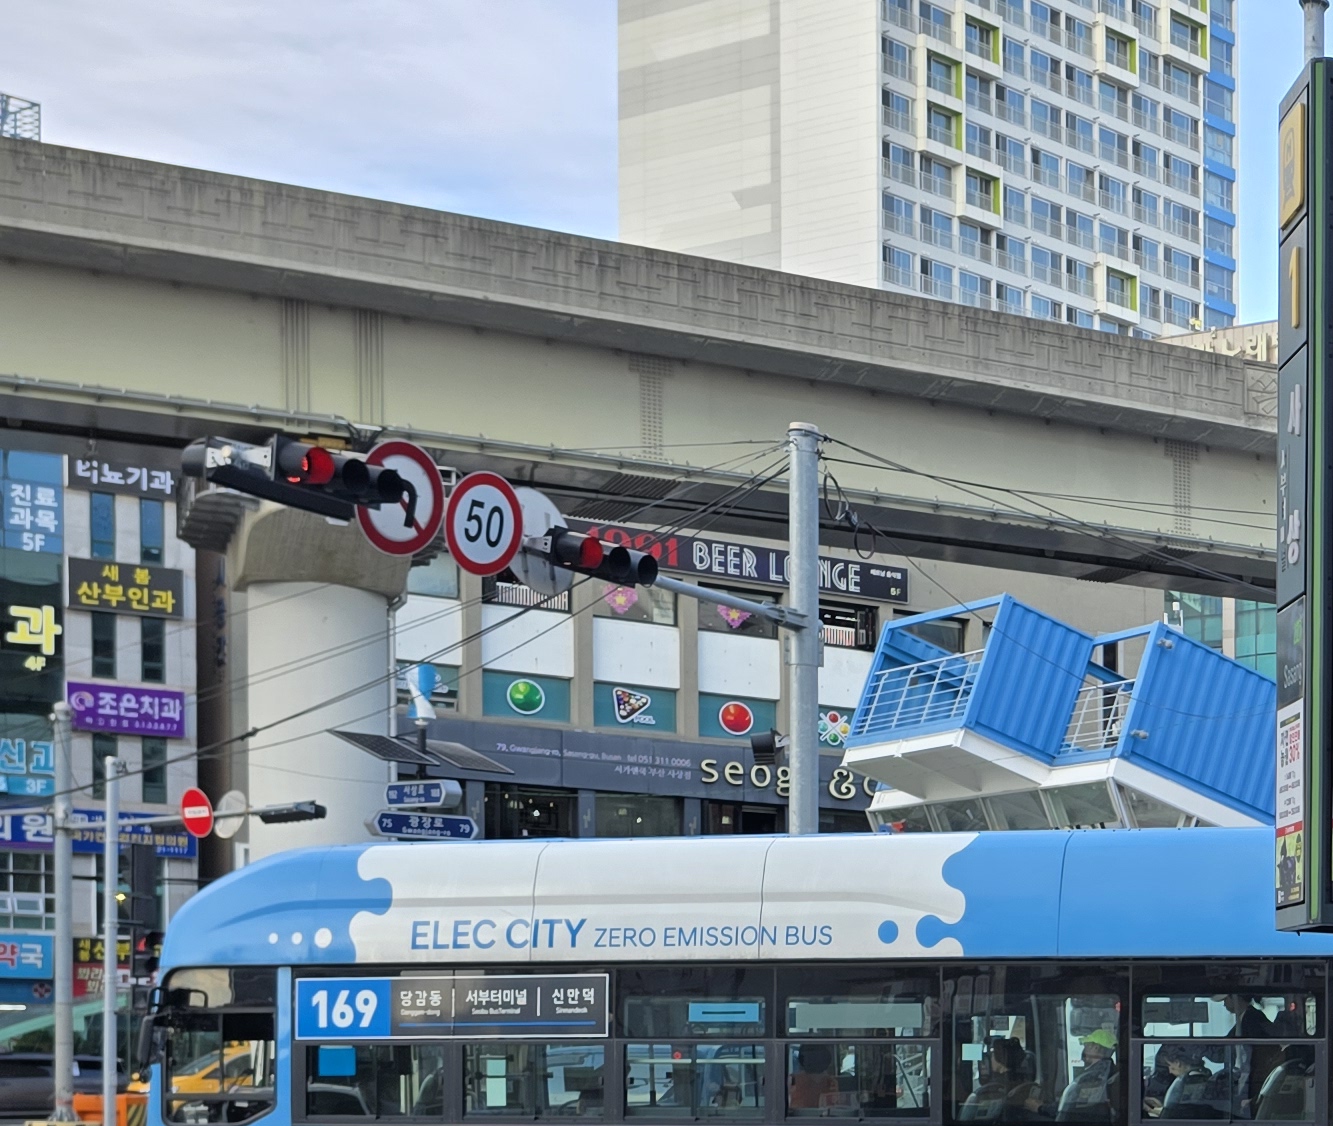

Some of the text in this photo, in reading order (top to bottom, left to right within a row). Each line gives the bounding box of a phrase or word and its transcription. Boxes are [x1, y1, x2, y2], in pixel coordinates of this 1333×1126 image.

[75, 459, 175, 494] 비뇨기과
[10, 483, 58, 507] 진료
[9, 507, 58, 533] 과목
[463, 498, 504, 549] 50
[22, 532, 46, 552] 5F
[693, 541, 757, 578] BEER
[769, 551, 861, 594] LNGE
[77, 581, 176, 613] 산부인과
[5, 604, 63, 656] 과
[97, 691, 183, 722] 조은치과
[26, 779, 47, 792] 3F
[700, 758, 789, 797] seog
[829, 769, 856, 800] &
[381, 816, 470, 834] 75 광장로 79
[411, 918, 833, 950] ELEC CITY ZERO EMISSION BUS
[311, 987, 595, 1028] 169 당감동 서부터미널 신만덕
